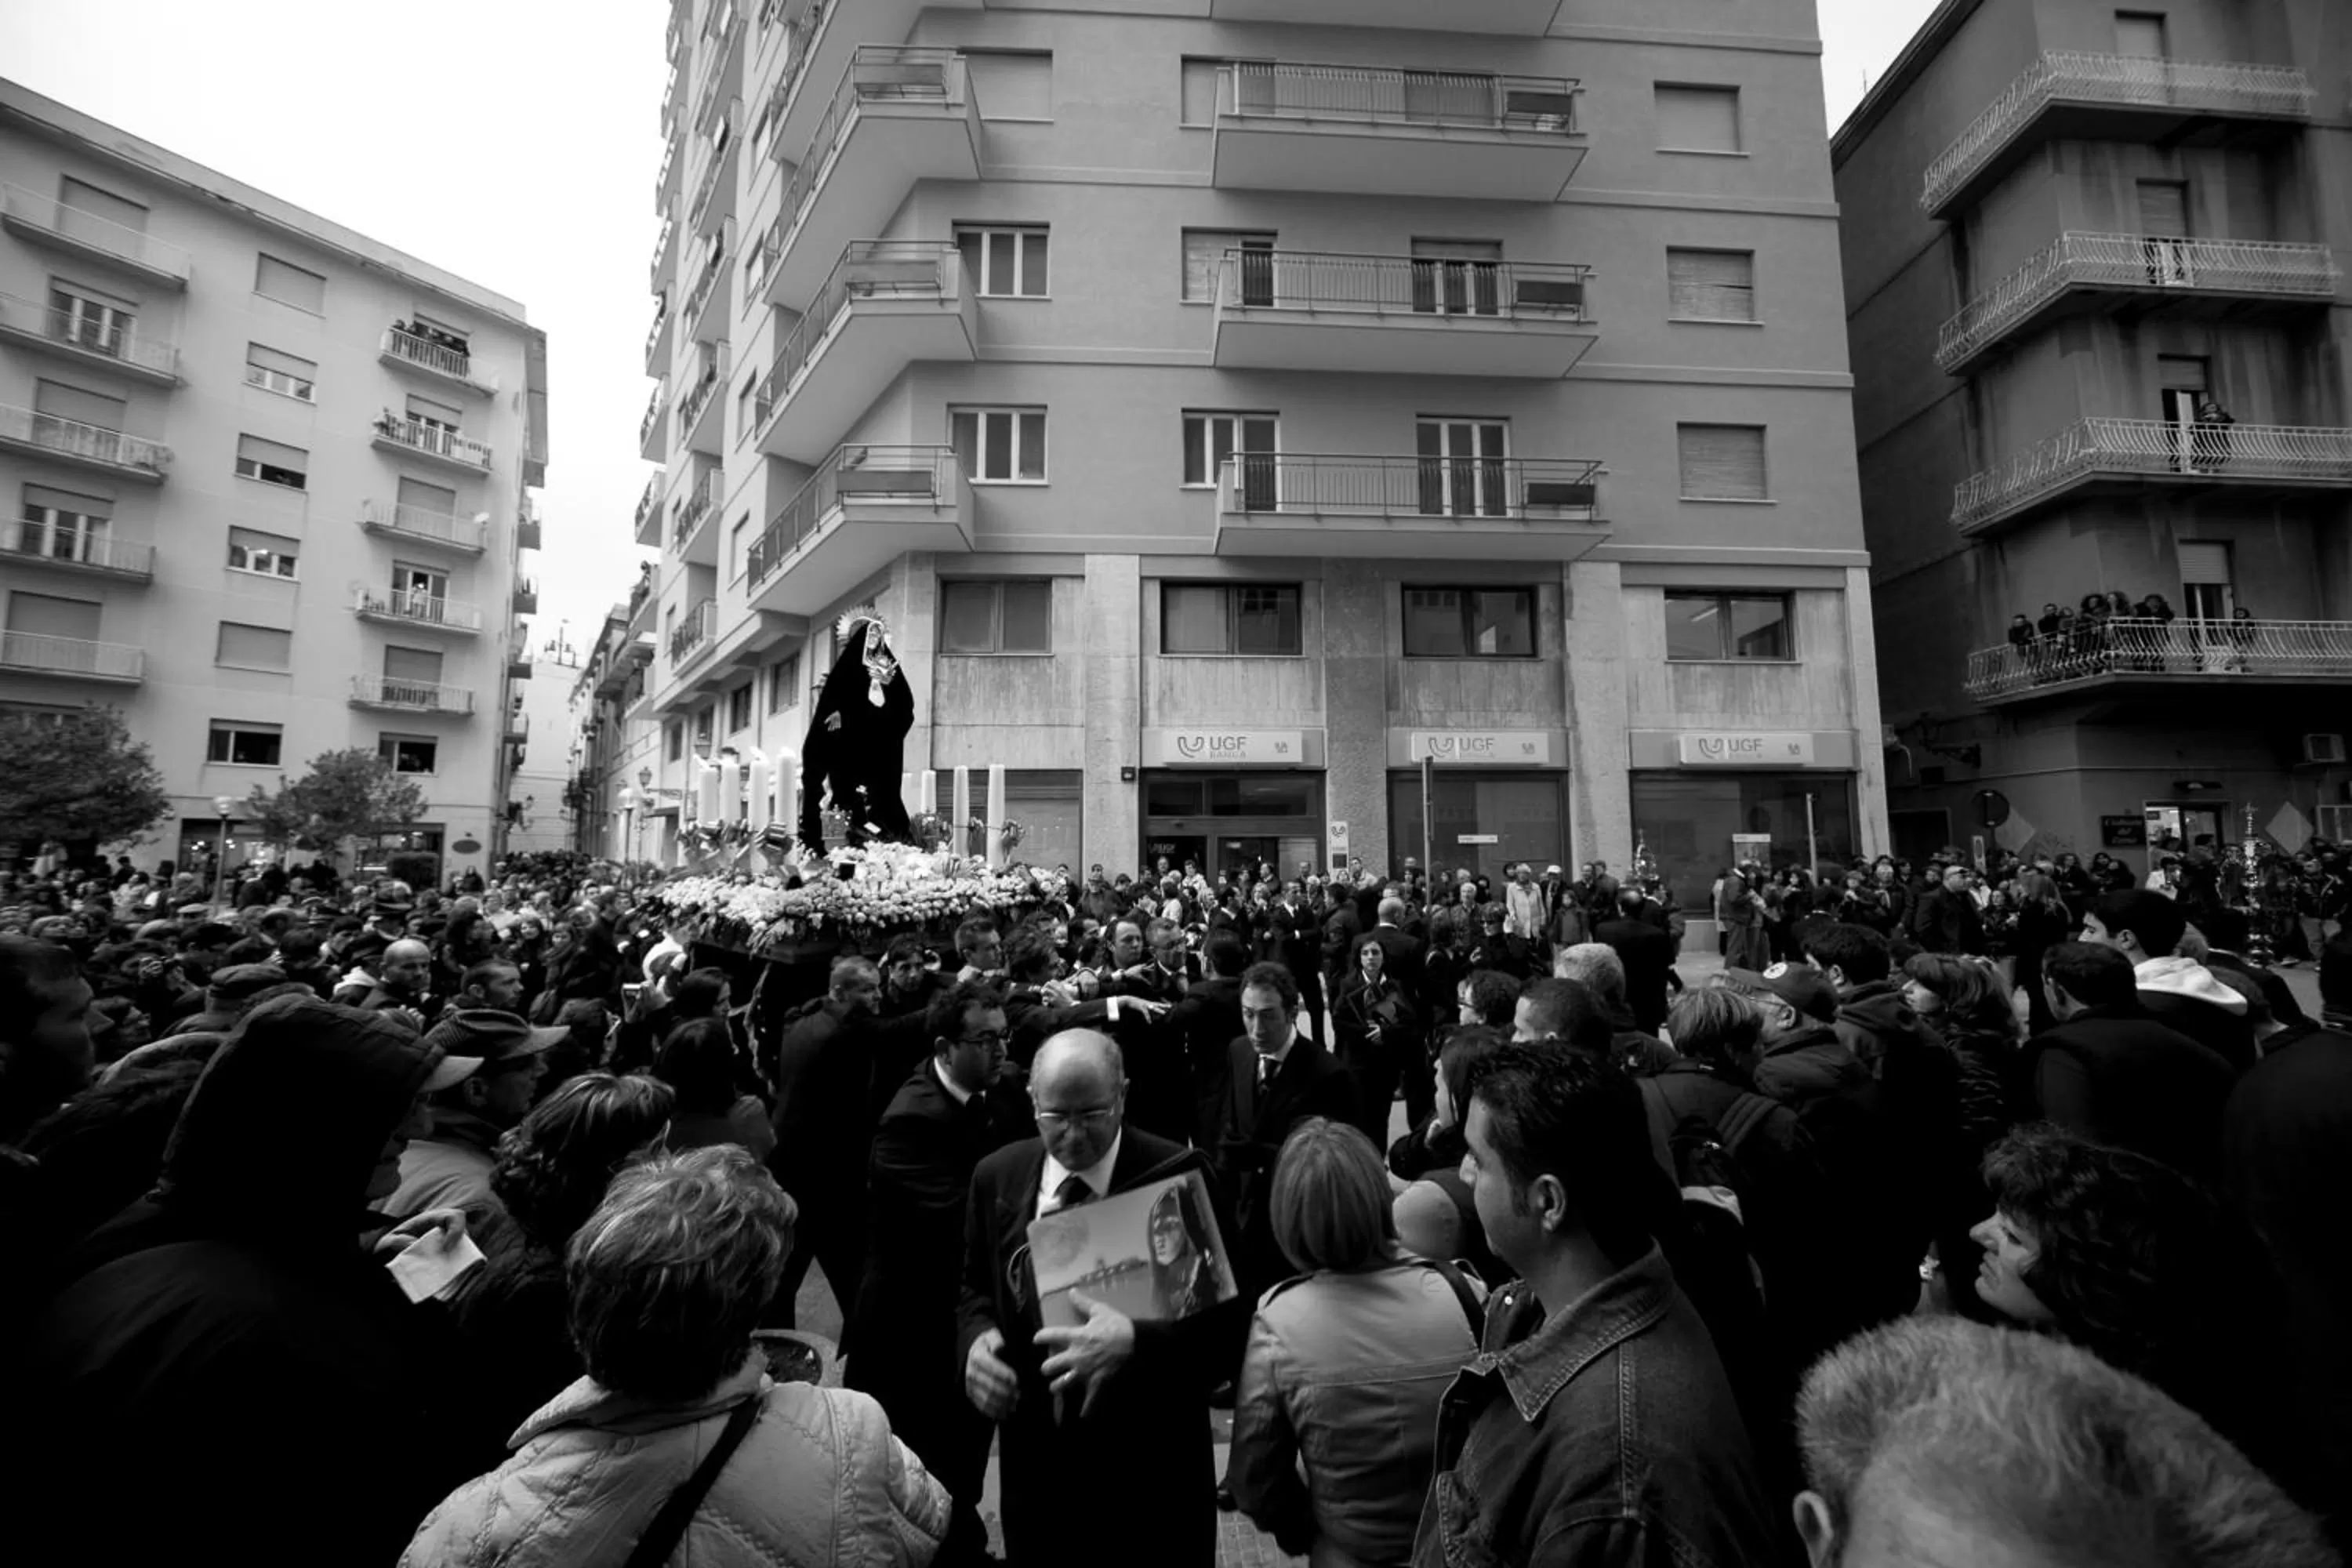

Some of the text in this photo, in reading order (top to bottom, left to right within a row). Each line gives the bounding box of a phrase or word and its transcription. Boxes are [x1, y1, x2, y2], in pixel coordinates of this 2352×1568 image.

[1210, 736, 1247, 750] UGF
[1459, 737, 1494, 750] UGF
[1728, 739, 1762, 751] UGF
